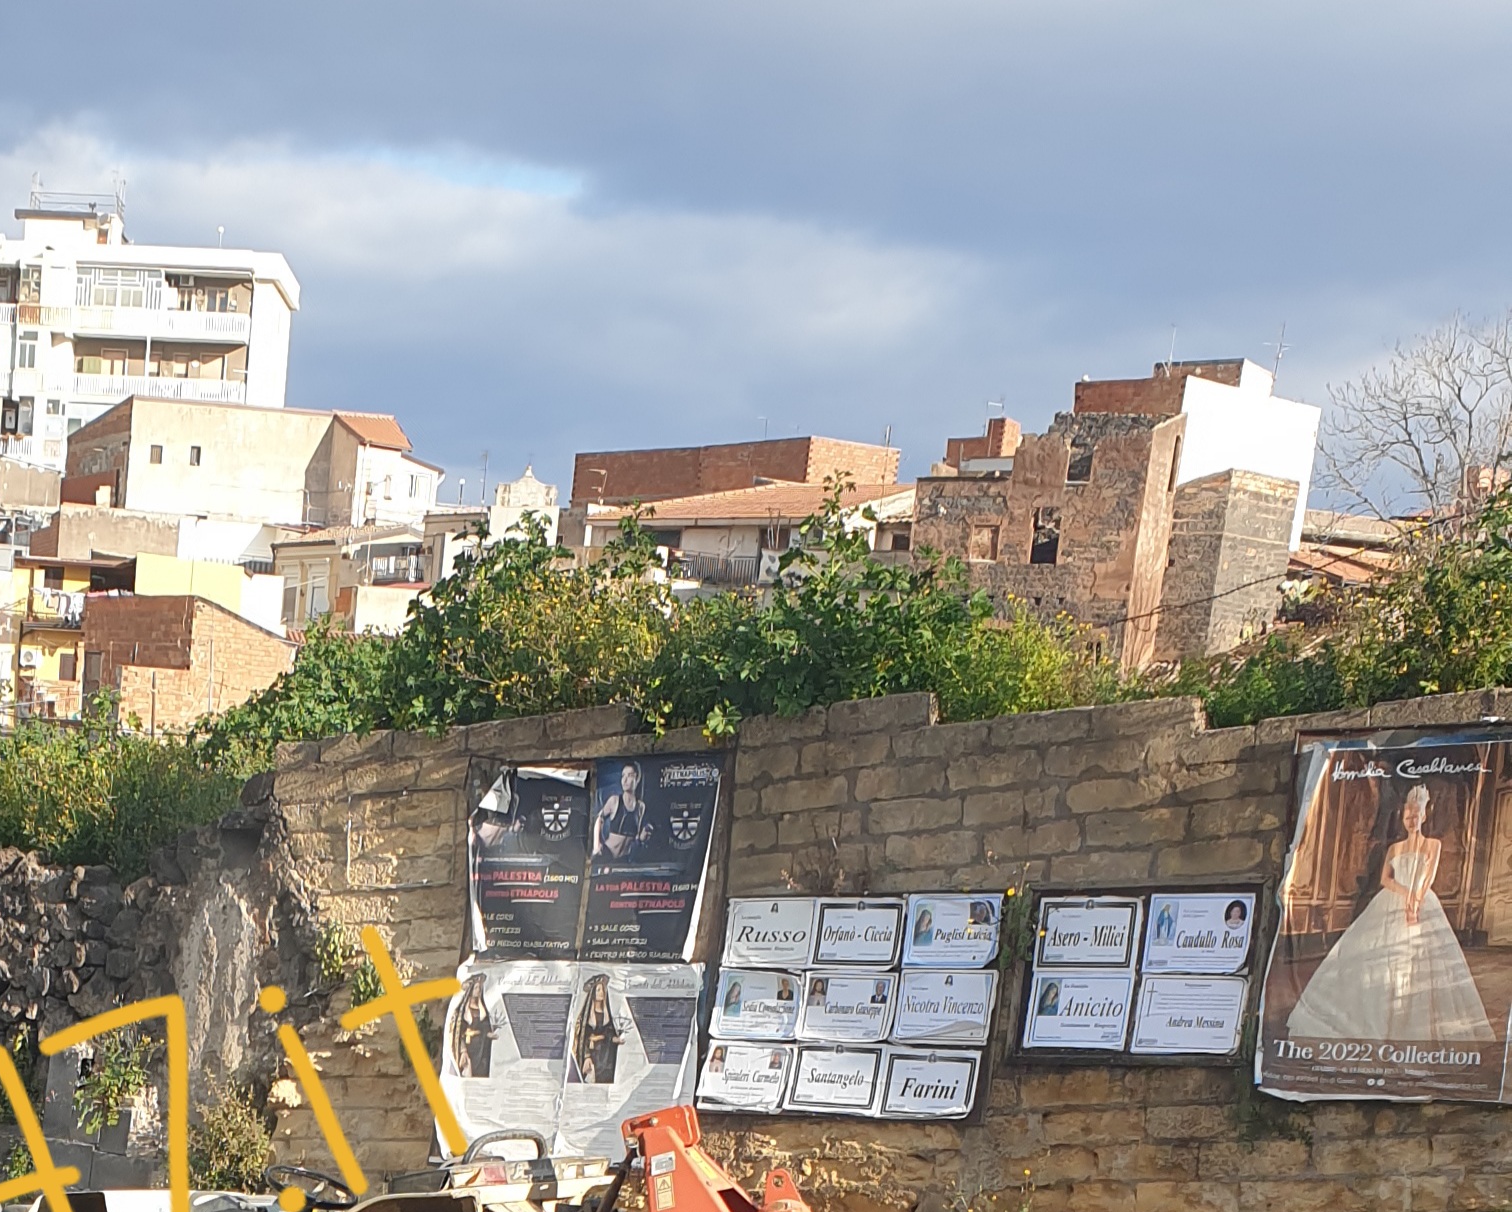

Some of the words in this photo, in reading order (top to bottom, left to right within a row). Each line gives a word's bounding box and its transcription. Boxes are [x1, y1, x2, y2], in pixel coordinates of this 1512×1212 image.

[1396, 757, 1492, 779] Casablanca
[492, 871, 542, 881] PALESTRA
[620, 881, 671, 892] PALESTRA
[600, 924, 618, 932] SALE
[735, 925, 807, 943] Russo
[864, 925, 893, 942] Ciccia
[1047, 926, 1081, 947] Asero
[1089, 925, 1126, 947] Milici
[1220, 930, 1245, 949] Rosa
[903, 996, 940, 1014] Nicotra
[942, 996, 984, 1014] Vincenzo
[1058, 996, 1124, 1017] Anicito
[1165, 1016, 1193, 1028] Andrea
[1273, 1039, 1313, 1061] The
[1318, 1042, 1373, 1063] 2022
[1378, 1044, 1481, 1066] Collection
[807, 1067, 865, 1090] Santangelo
[899, 1077, 960, 1101] Farini
